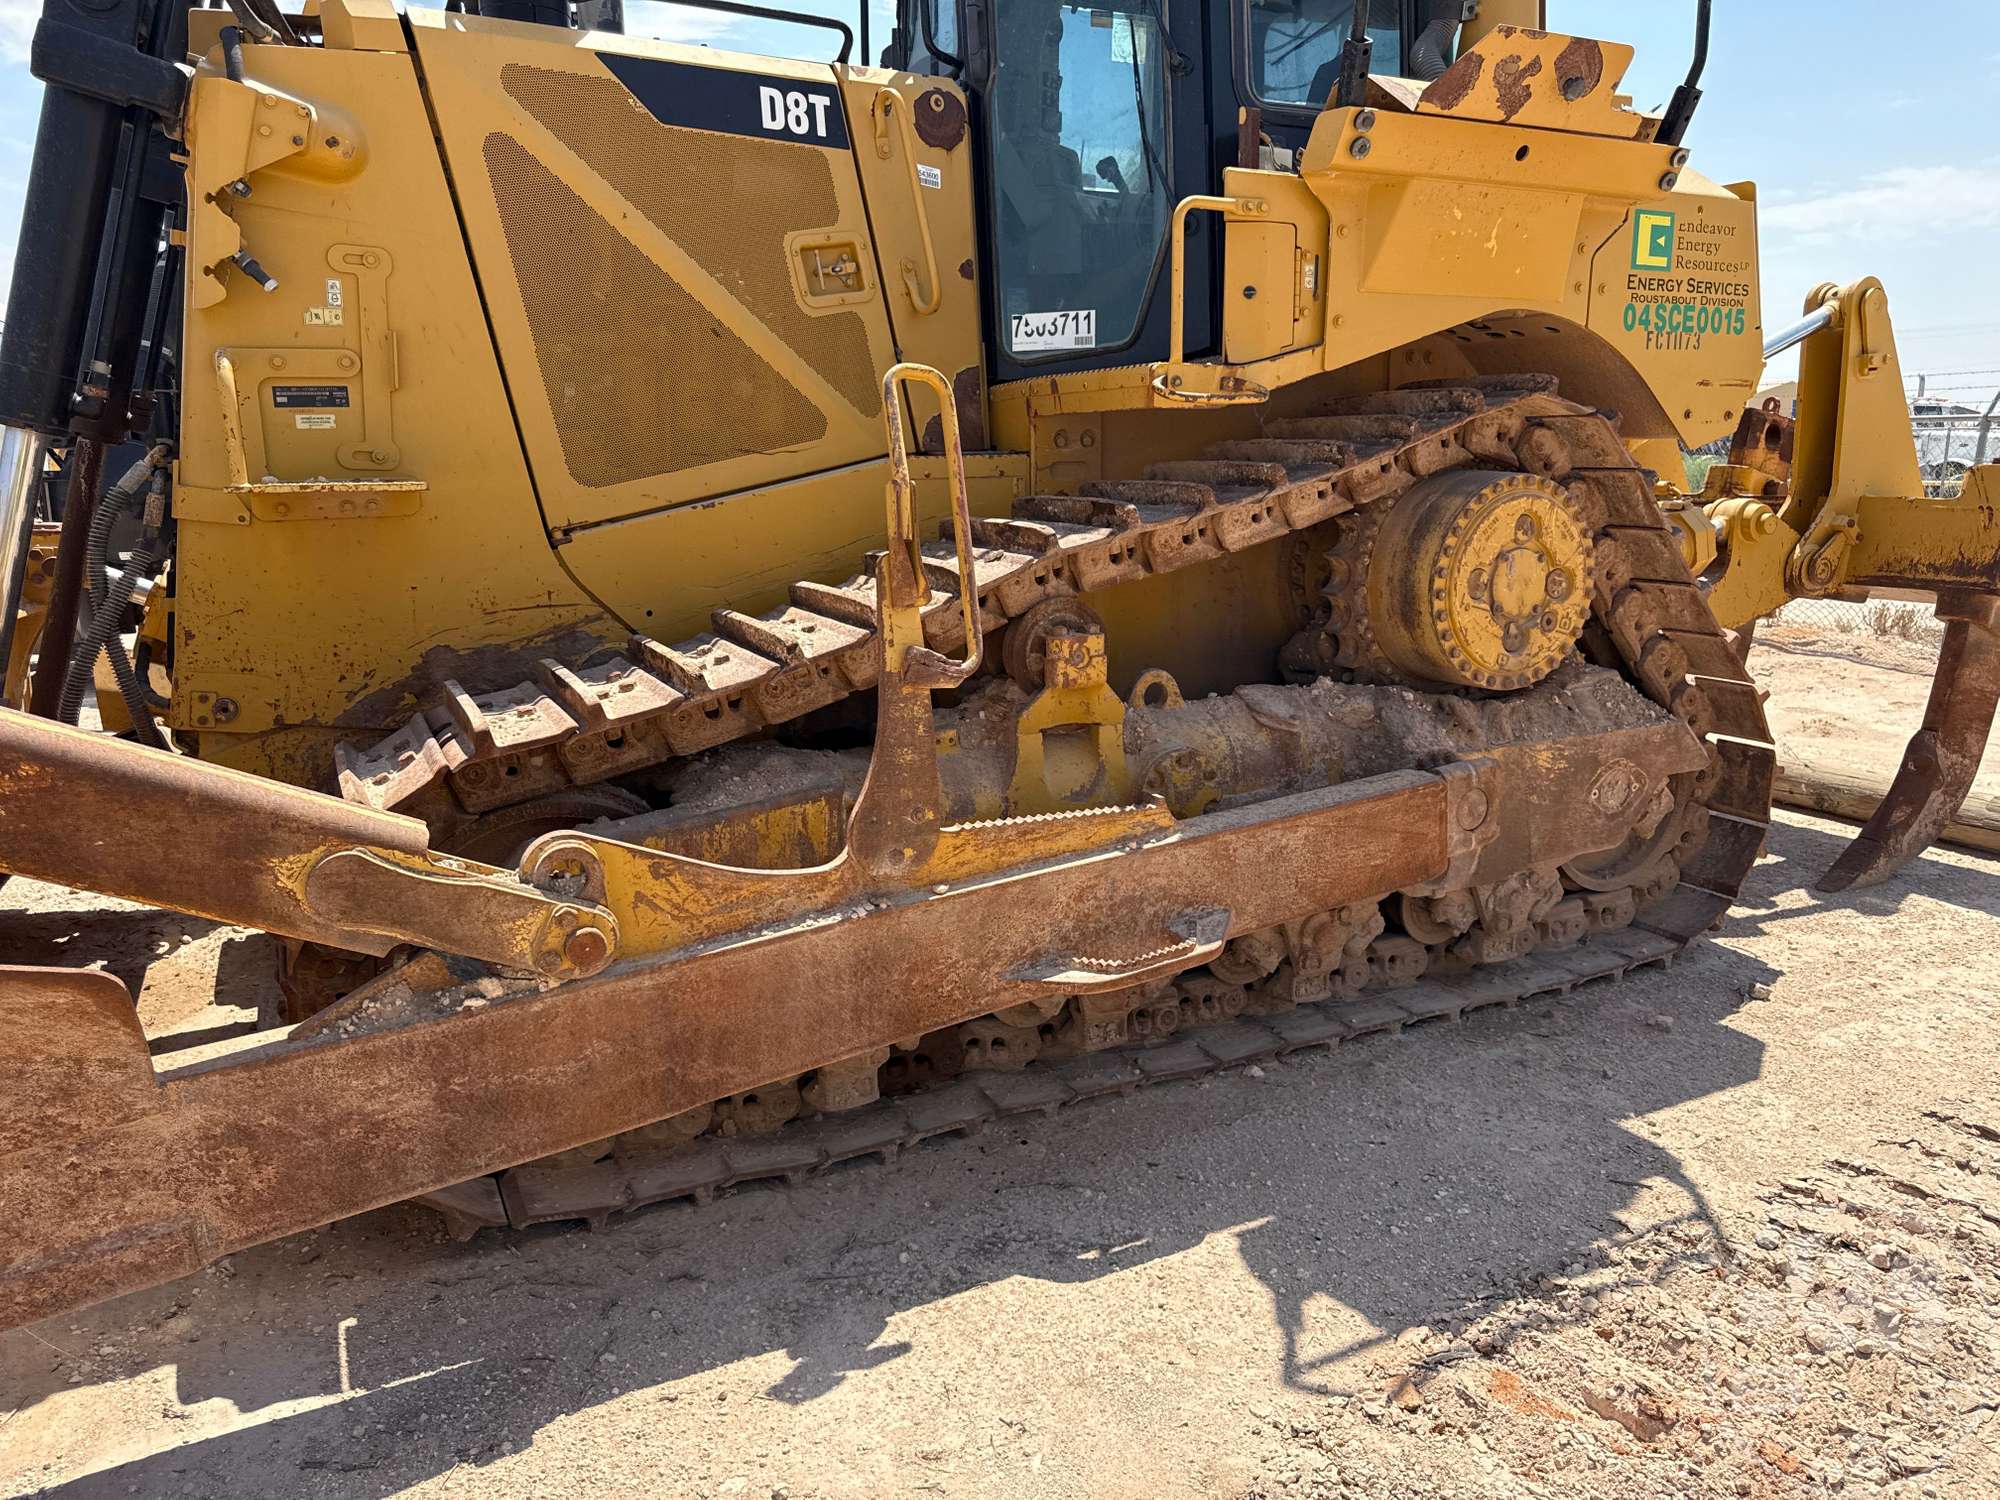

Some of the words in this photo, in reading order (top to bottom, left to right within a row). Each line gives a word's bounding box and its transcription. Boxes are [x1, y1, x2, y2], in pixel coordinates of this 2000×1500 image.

[759, 86, 830, 137] D8T
[1678, 219, 1737, 236] Endeavor
[1677, 237, 1721, 256] Energy
[1675, 255, 1738, 273] Resources
[1627, 274, 1683, 292] ENERGY
[1686, 278, 1749, 297] SERVICES
[1630, 293, 1697, 305] ROUSTABOUT
[1700, 296, 1744, 307] DIVISION
[1623, 303, 1745, 335] 04SCE0015
